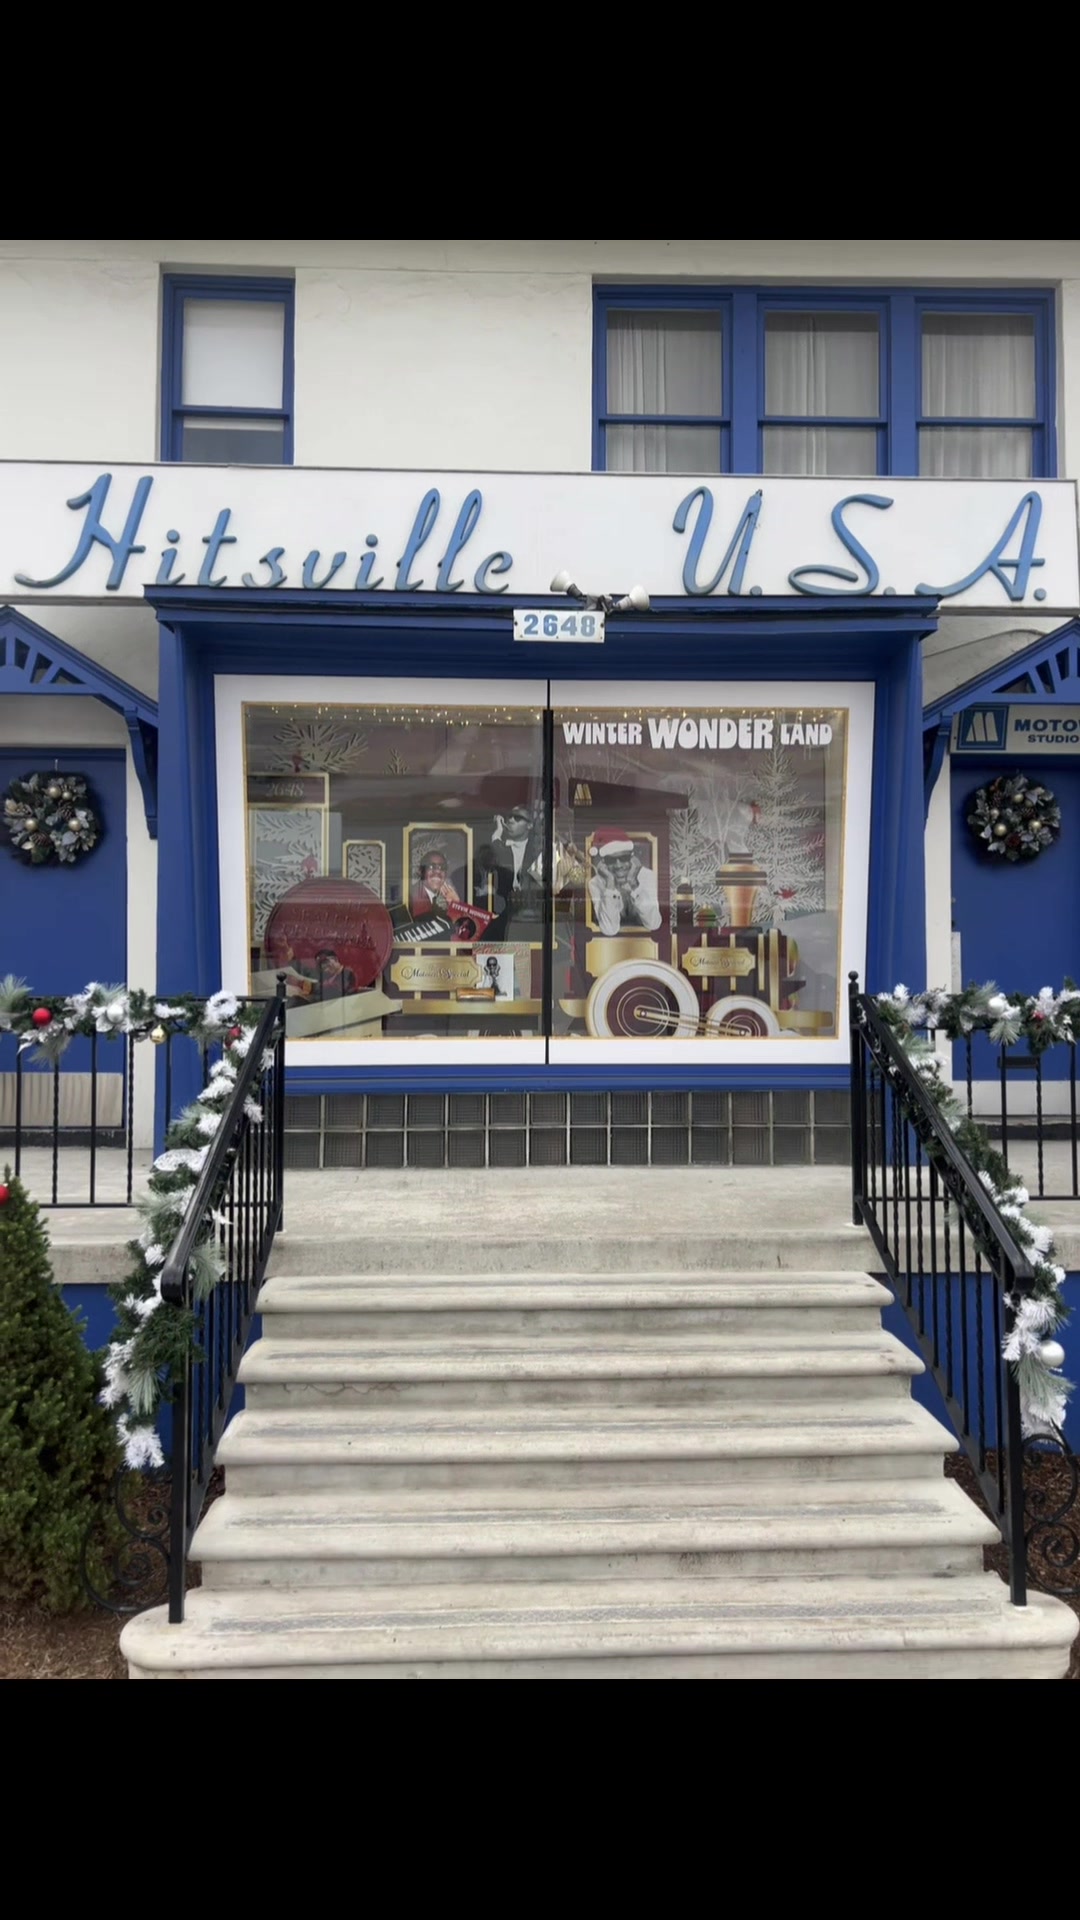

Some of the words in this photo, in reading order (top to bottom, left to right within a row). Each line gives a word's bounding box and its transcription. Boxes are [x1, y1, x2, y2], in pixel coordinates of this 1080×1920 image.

[14, 472, 513, 595] Hitsville
[523, 613, 596, 637] 2648
[562, 721, 642, 745] WINTER
[647, 717, 774, 749] WONDER
[780, 723, 833, 745] LAND
[1014, 719, 1080, 733] MOTO
